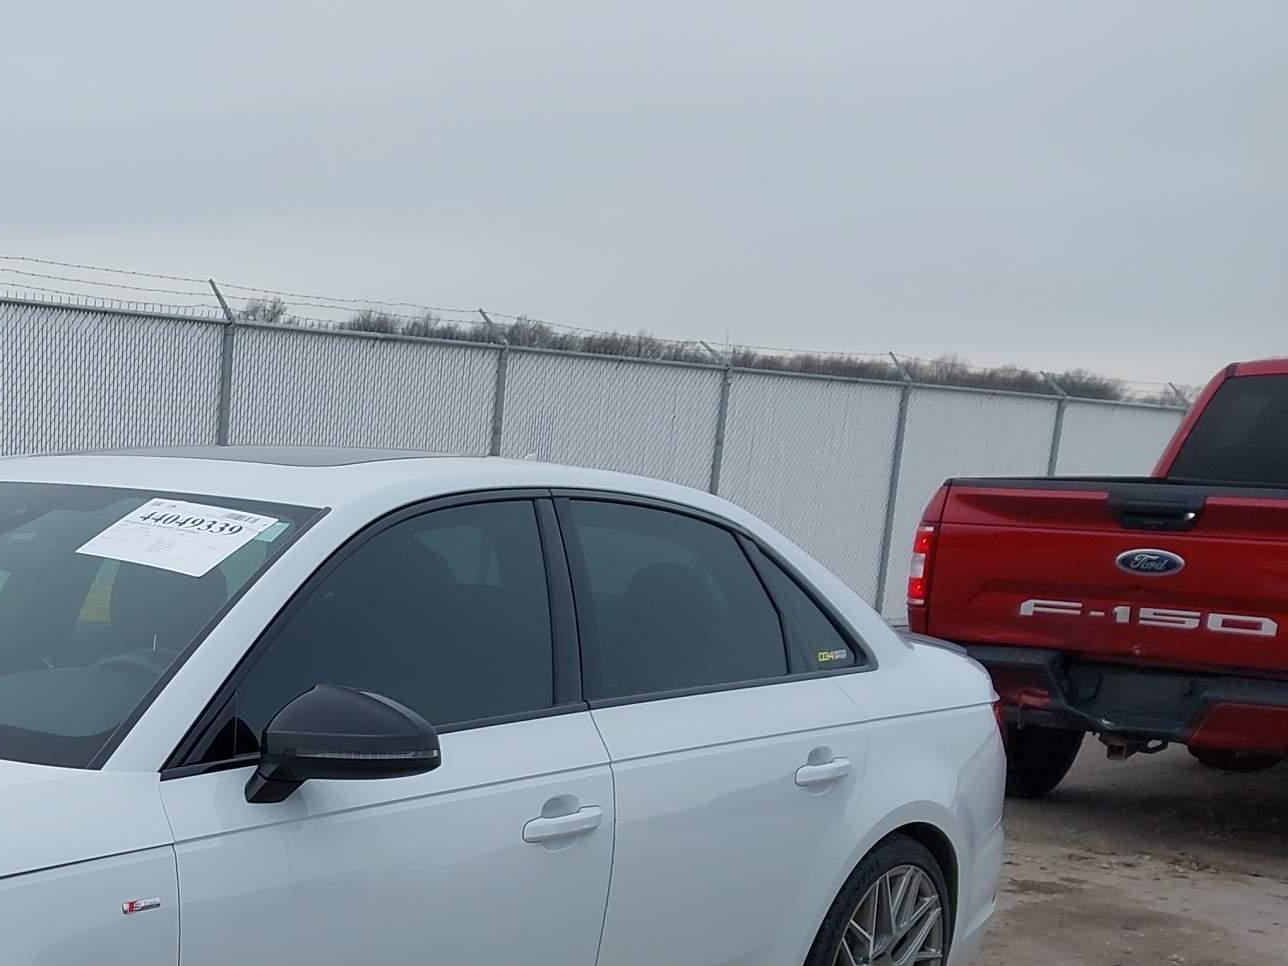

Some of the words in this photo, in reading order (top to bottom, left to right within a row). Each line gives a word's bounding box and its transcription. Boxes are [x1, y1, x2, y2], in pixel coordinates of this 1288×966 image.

[139, 511, 243, 536] 44049339
[1131, 553, 1168, 571] Ford
[1020, 599, 1278, 636] F-150
